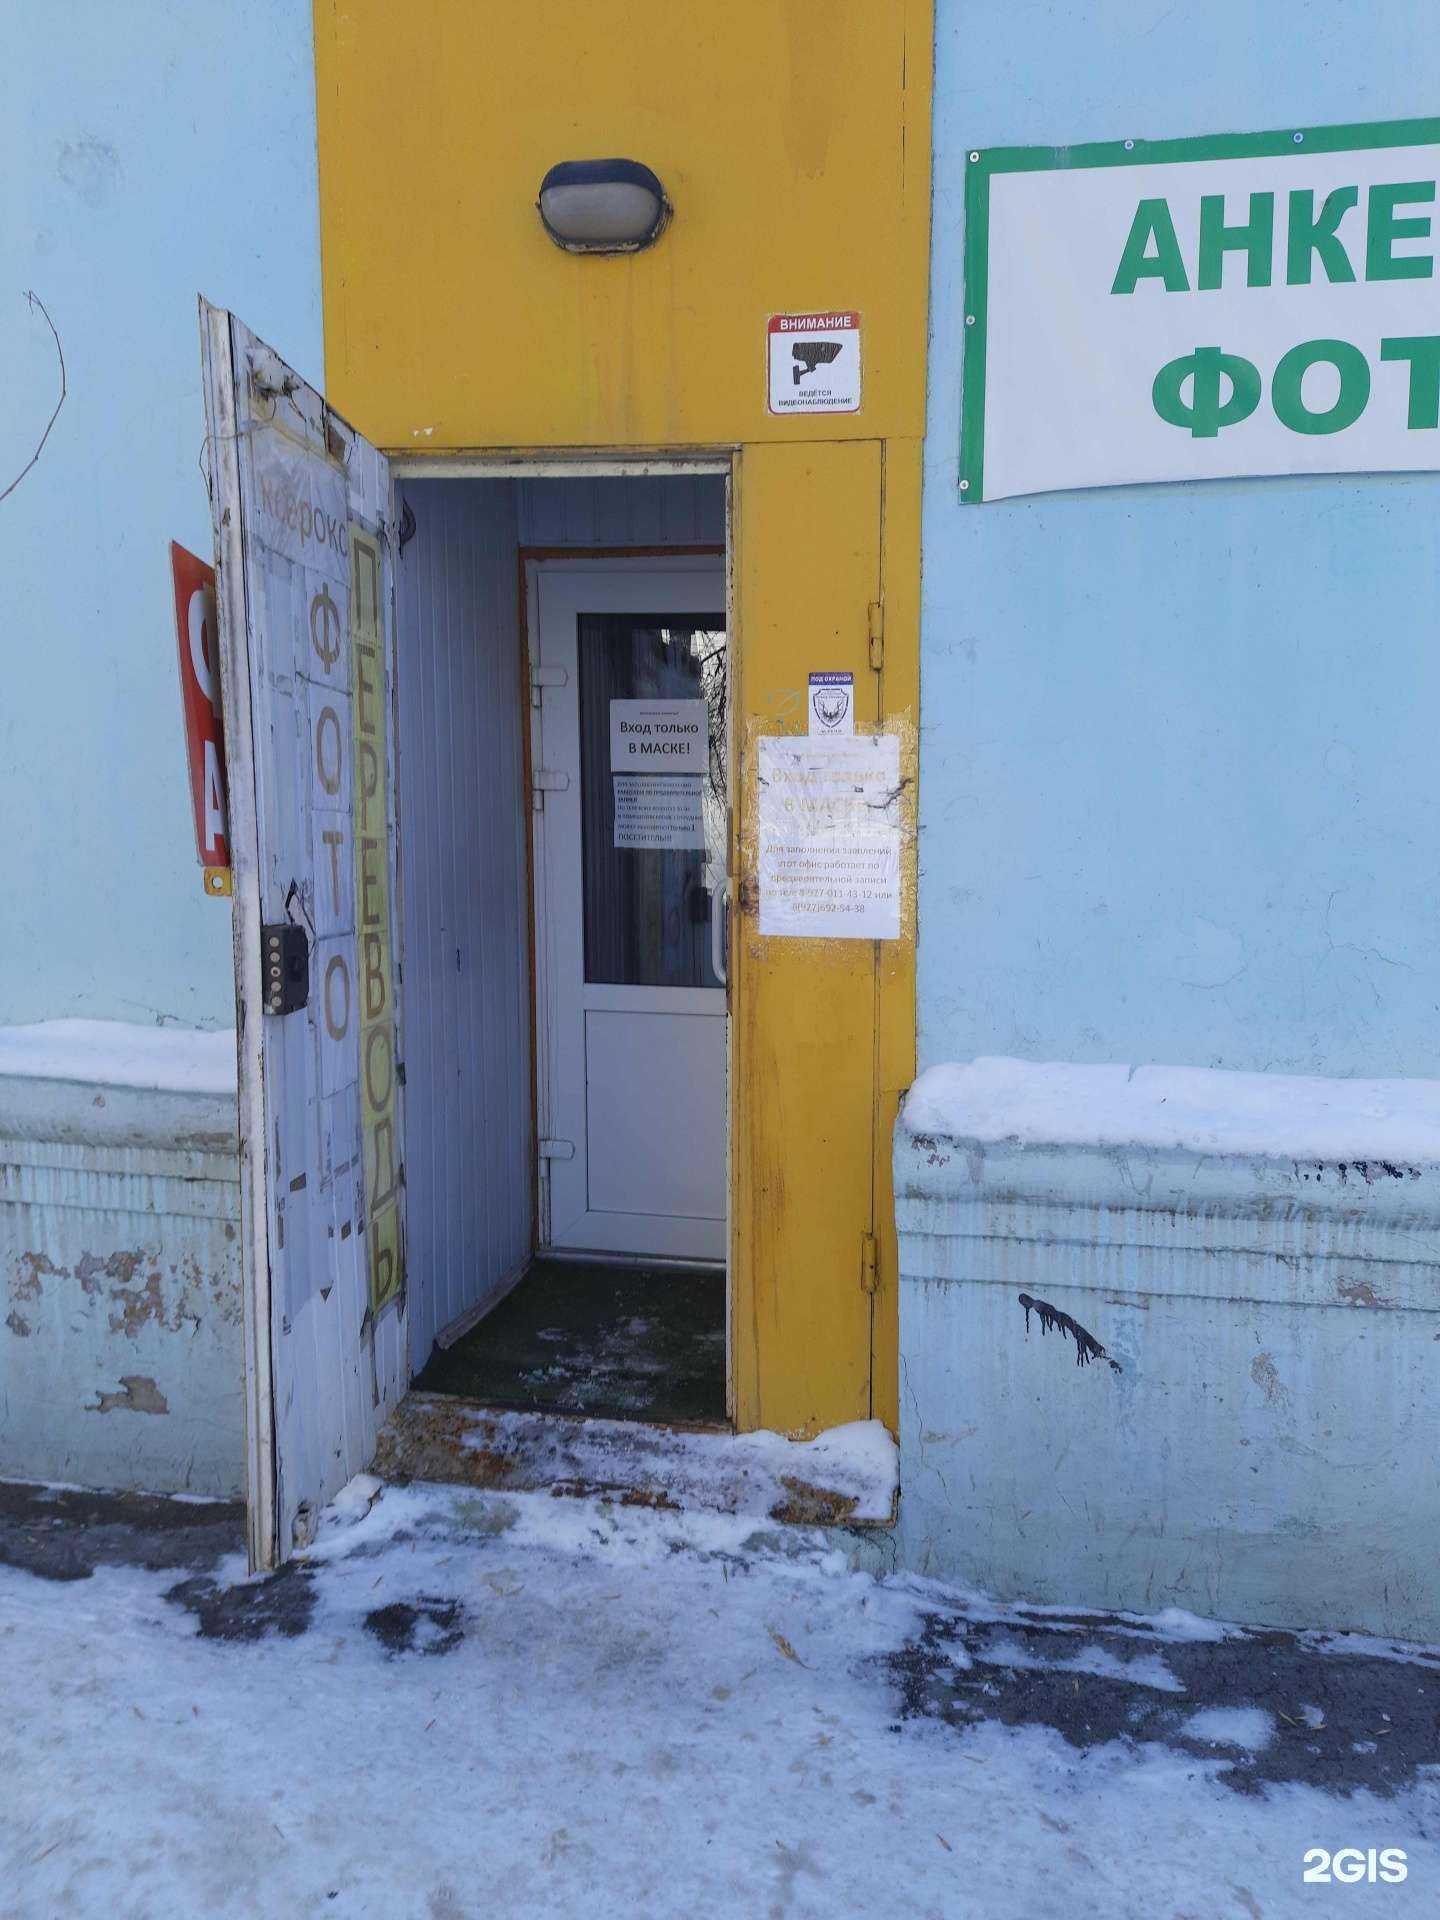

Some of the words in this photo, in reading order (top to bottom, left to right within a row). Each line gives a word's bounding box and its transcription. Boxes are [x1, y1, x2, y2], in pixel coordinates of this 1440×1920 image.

[1110, 180, 1437, 295] АНКЕ
[780, 316, 852, 330] ВНИМАНИЕ
[1151, 335, 1440, 438] ФОТ
[620, 721, 651, 735] Вход
[654, 724, 699, 734] только
[640, 742, 691, 755] МАСКЕ!
[798, 858, 822, 871] офис
[824, 859, 866, 870] работает
